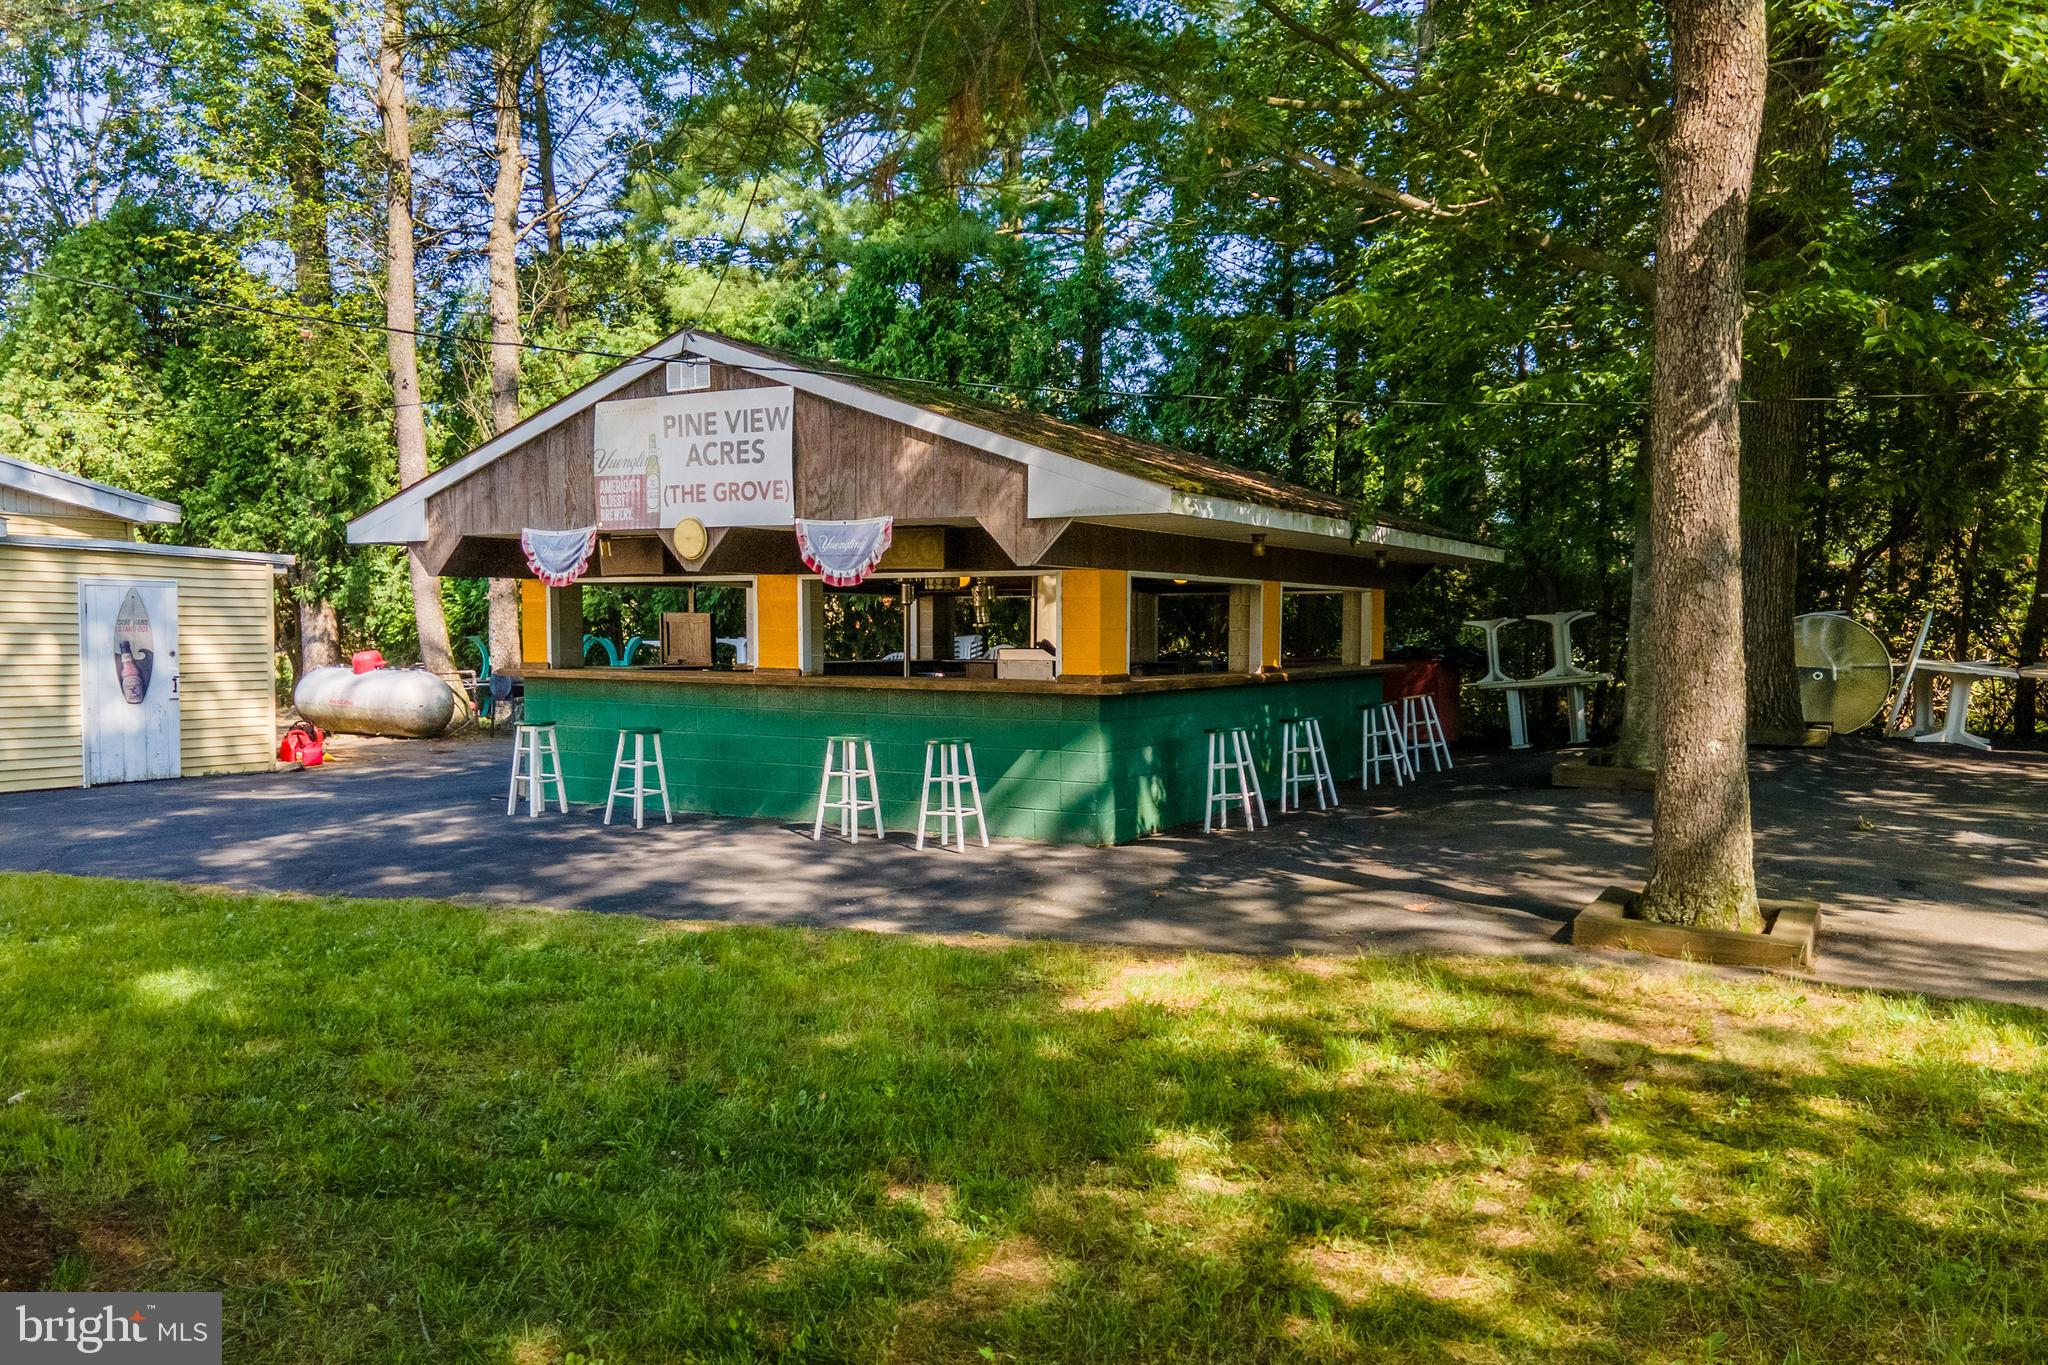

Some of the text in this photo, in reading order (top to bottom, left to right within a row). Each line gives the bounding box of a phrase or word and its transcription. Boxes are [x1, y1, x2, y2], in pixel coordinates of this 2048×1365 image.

[663, 406, 790, 439] PINE VIEW
[685, 438, 765, 467] ACRES
[600, 494, 625, 507] OLDEST
[664, 483, 707, 507] (THE
[713, 479, 790, 503] GROVE)
[819, 535, 869, 553] Yuengling
